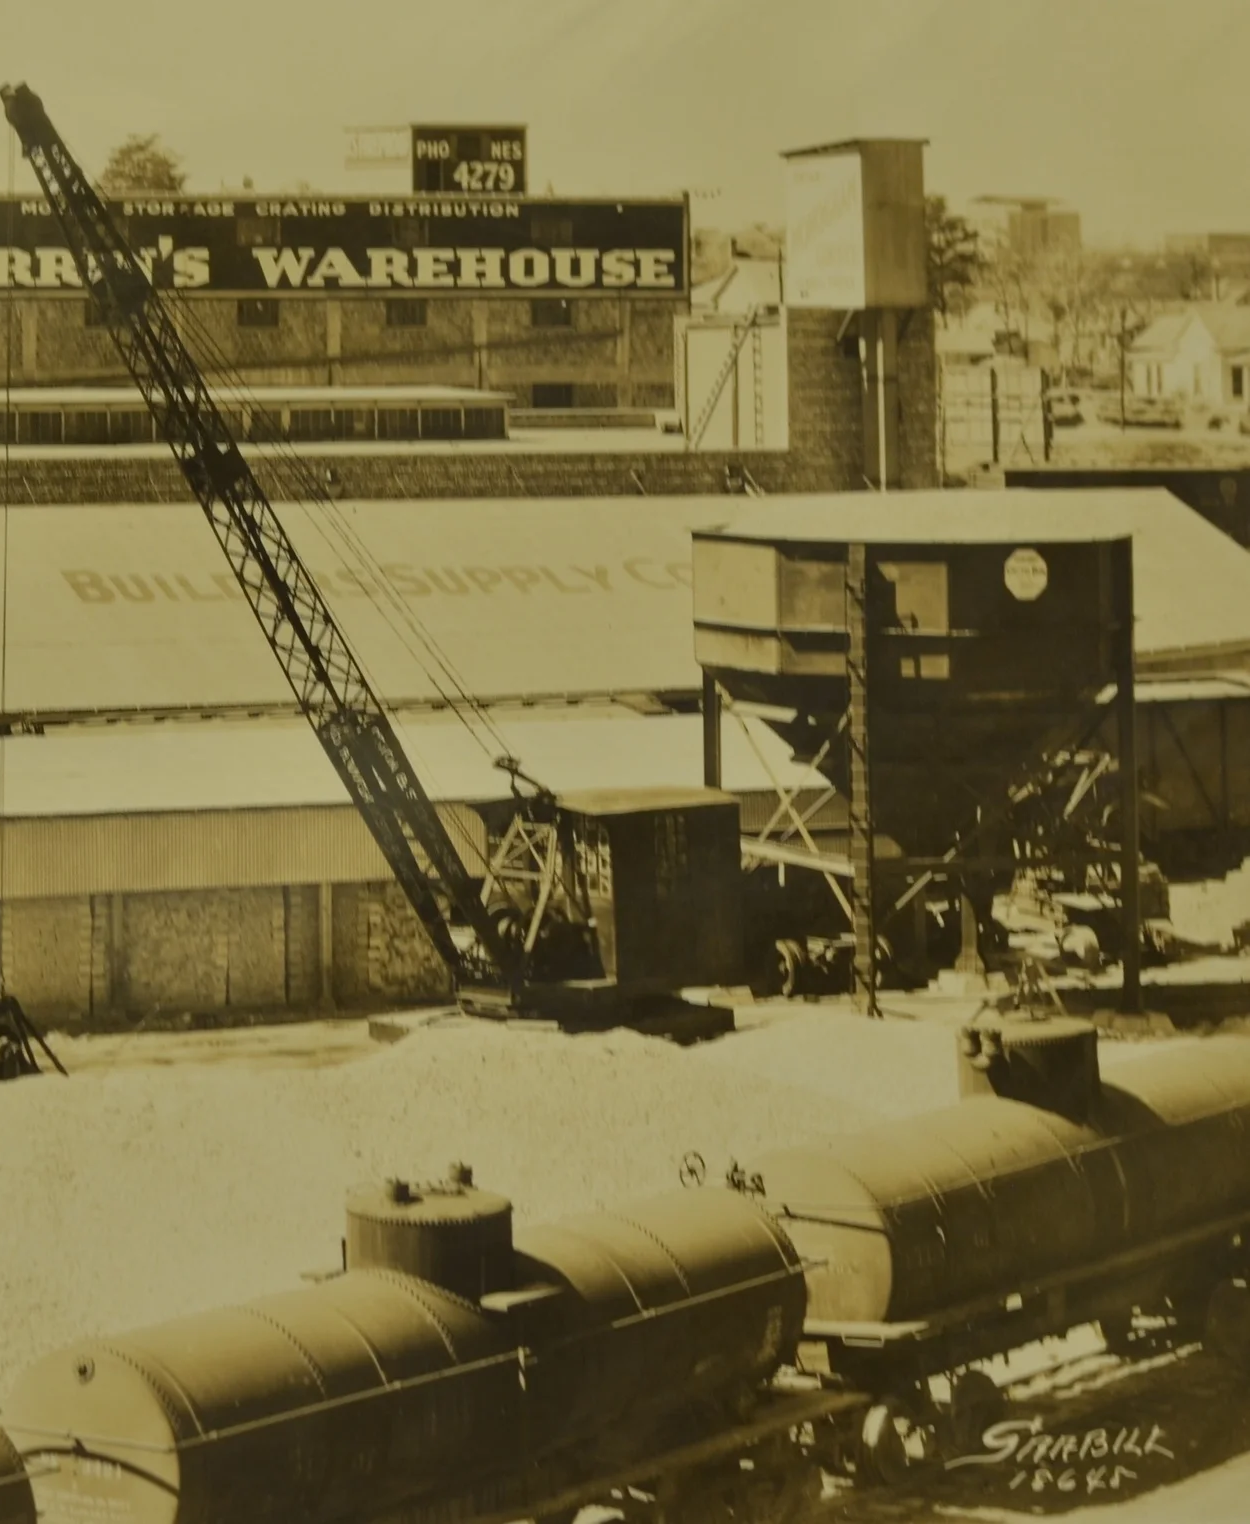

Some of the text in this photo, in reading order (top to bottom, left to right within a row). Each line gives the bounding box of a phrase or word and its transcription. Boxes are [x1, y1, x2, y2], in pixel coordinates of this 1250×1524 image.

[453, 160, 515, 192] 4279
[255, 201, 346, 217] CRATING
[369, 201, 519, 218] DISTRIBUTION
[252, 247, 676, 288] WAREHOUSE
[383, 562, 614, 597] SUPPLY
